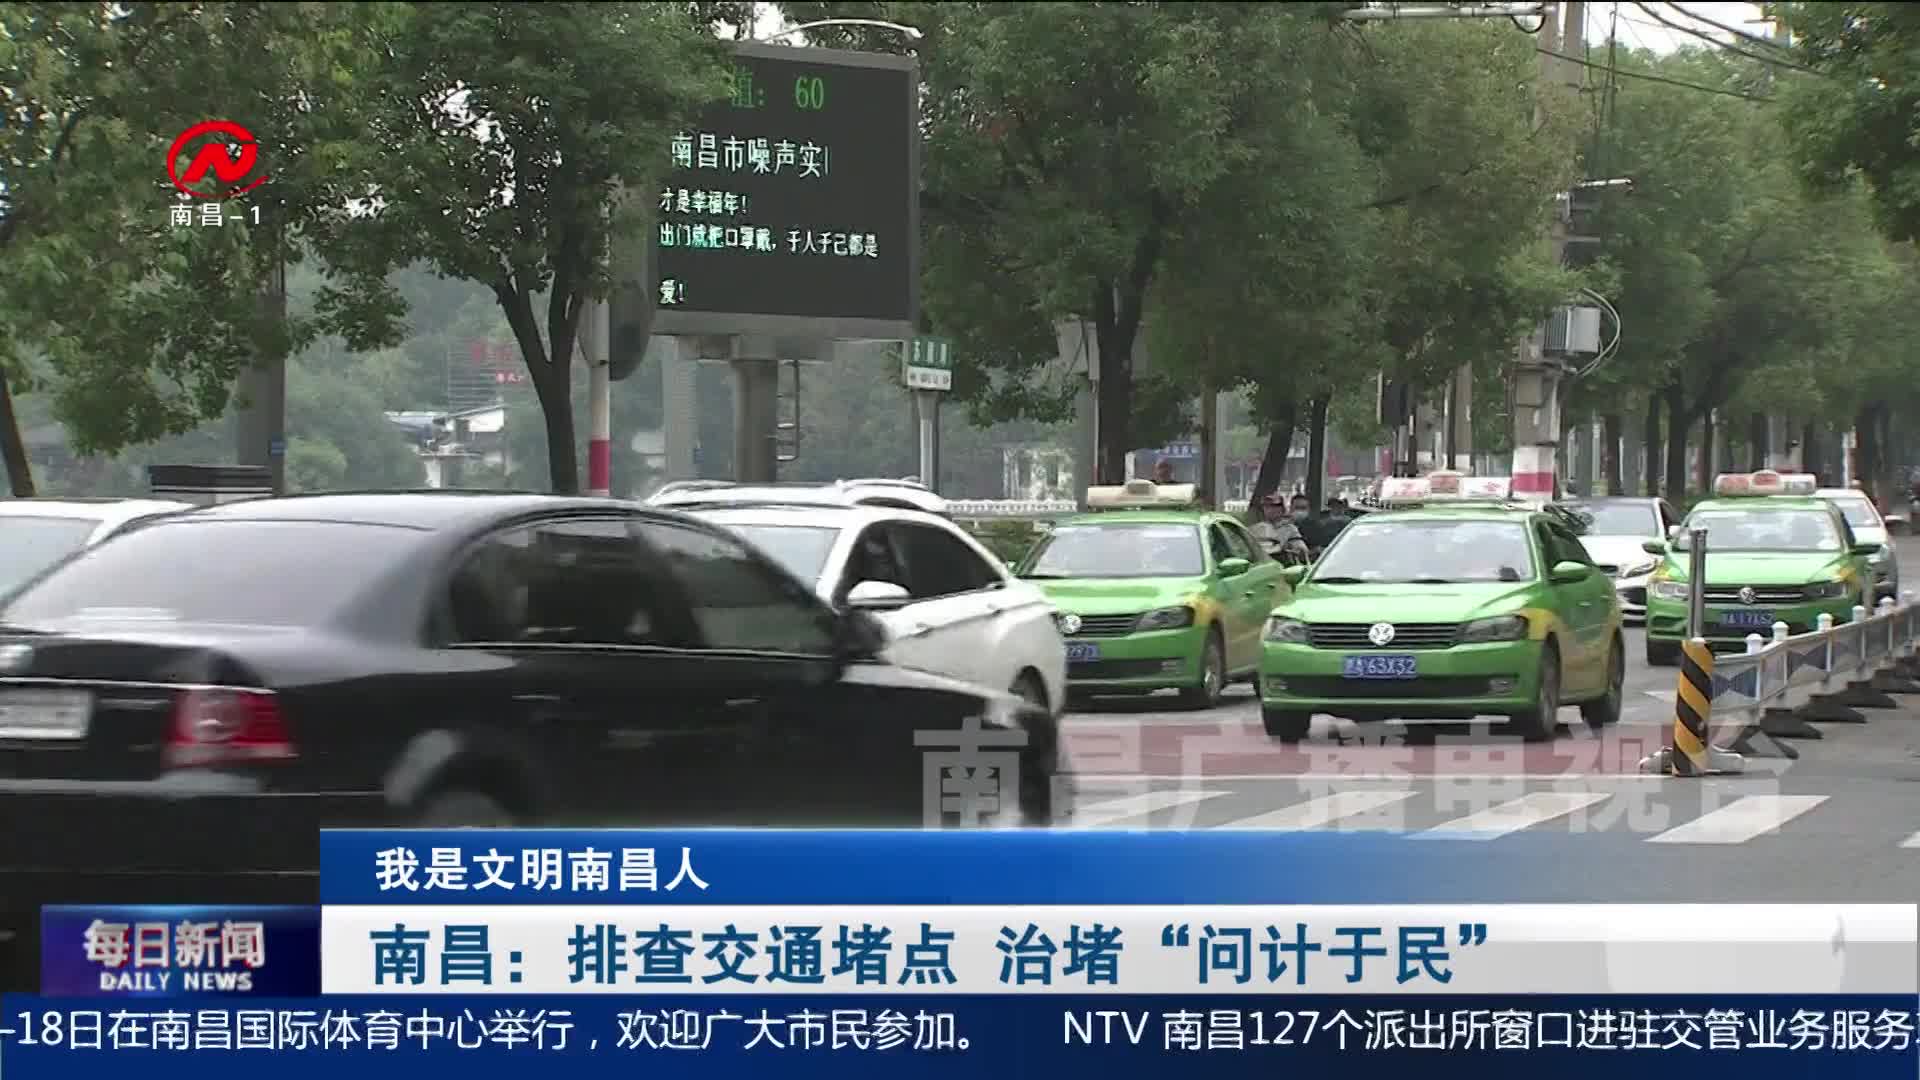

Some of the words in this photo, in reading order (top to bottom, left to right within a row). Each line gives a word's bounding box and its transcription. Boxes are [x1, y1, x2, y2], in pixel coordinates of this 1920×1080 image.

[795, 75, 824, 109] 60
[671, 131, 830, 178] 南昌市噪声实
